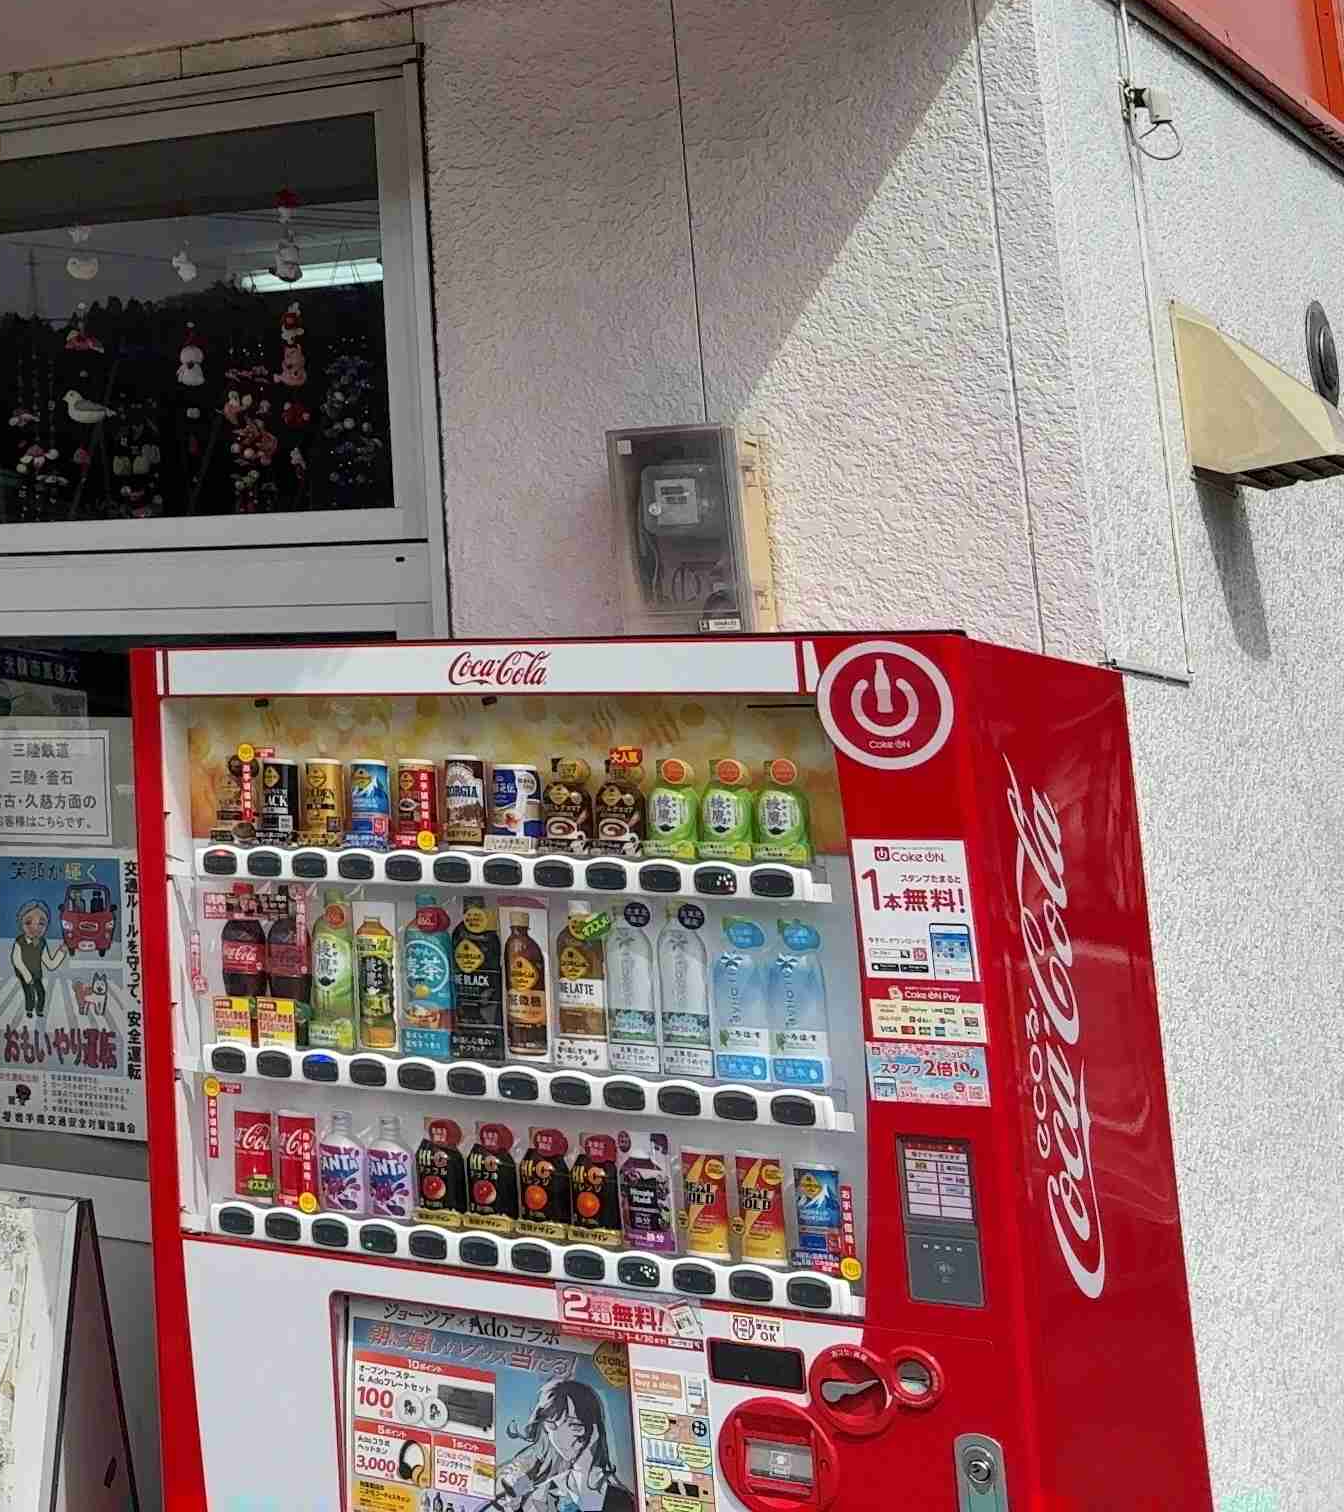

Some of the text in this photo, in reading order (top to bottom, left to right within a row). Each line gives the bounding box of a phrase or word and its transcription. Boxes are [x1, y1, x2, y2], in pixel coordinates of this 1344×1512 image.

[448, 650, 552, 687] Coca-Cola
[891, 851, 923, 863] Coke
[900, 874, 962, 884] スタンプたまると
[861, 868, 966, 914] 1本無料!
[1002, 753, 1106, 1299] Coca-Cola
[319, 1154, 359, 1172] ANTA
[759, 1331, 777, 1343] OK
[356, 1385, 394, 1409] 100
[356, 1454, 396, 1474] 3,000
